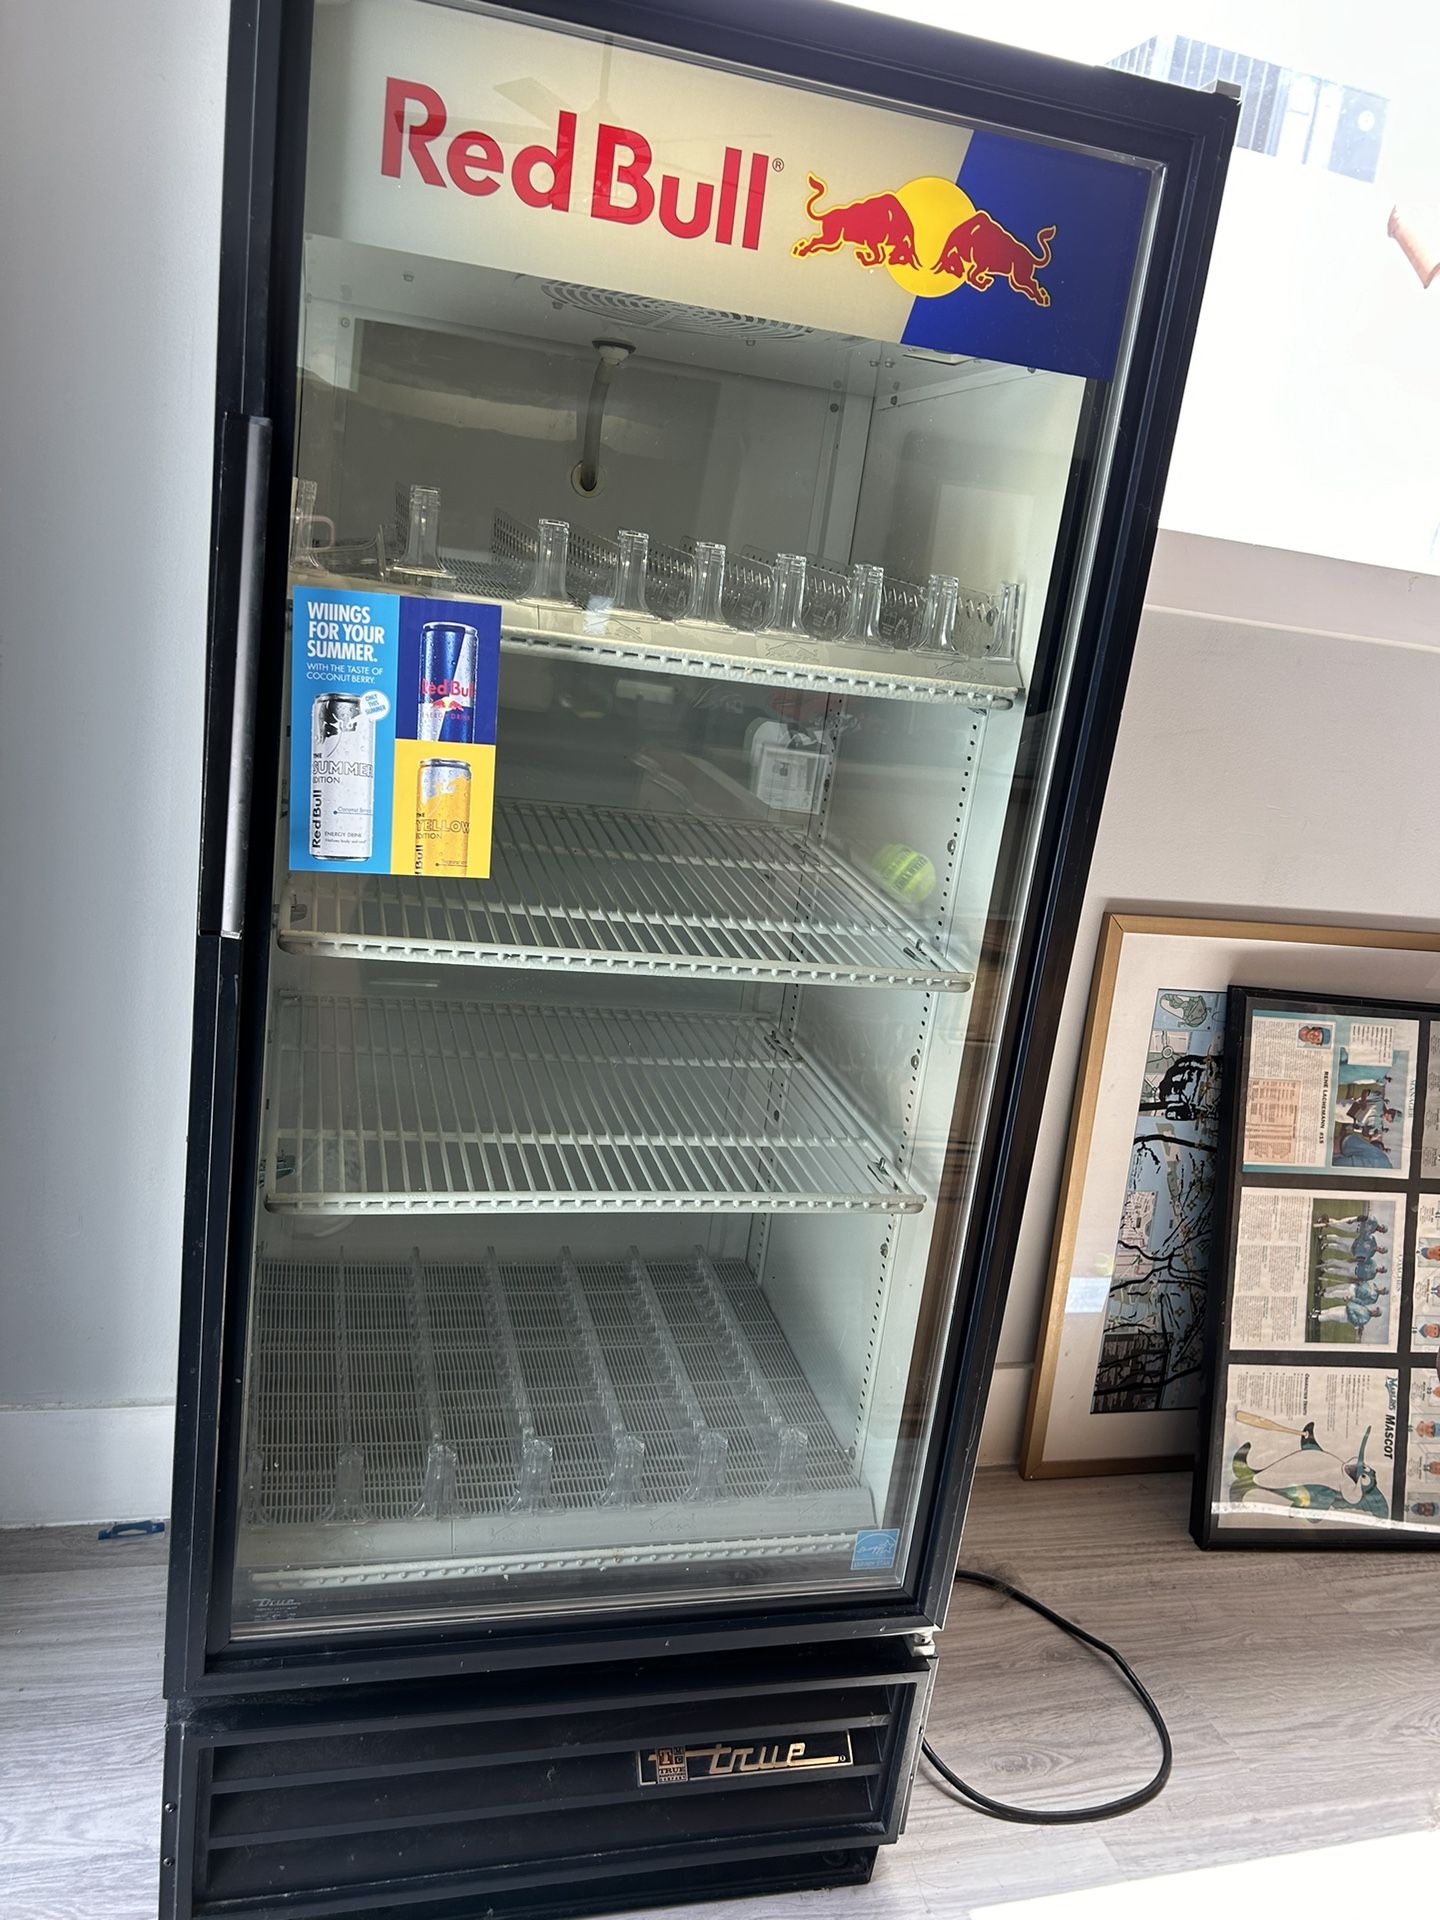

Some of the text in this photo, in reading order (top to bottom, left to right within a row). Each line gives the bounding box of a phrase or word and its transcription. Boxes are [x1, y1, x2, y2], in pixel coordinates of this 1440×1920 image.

[381, 76, 578, 213] Red
[307, 601, 371, 625] WIIINGS
[309, 620, 385, 644] FOR YOUR
[307, 639, 378, 663] SUMMER.
[306, 662, 384, 676] WITH THE TASTE OF
[306, 671, 350, 682] COCONUT
[311, 789, 322, 848] Red Bull
[1320, 1089, 1328, 1129] LACHEMANN
[1384, 1414, 1396, 1460] MASCOT
[690, 1742, 839, 1775] true
